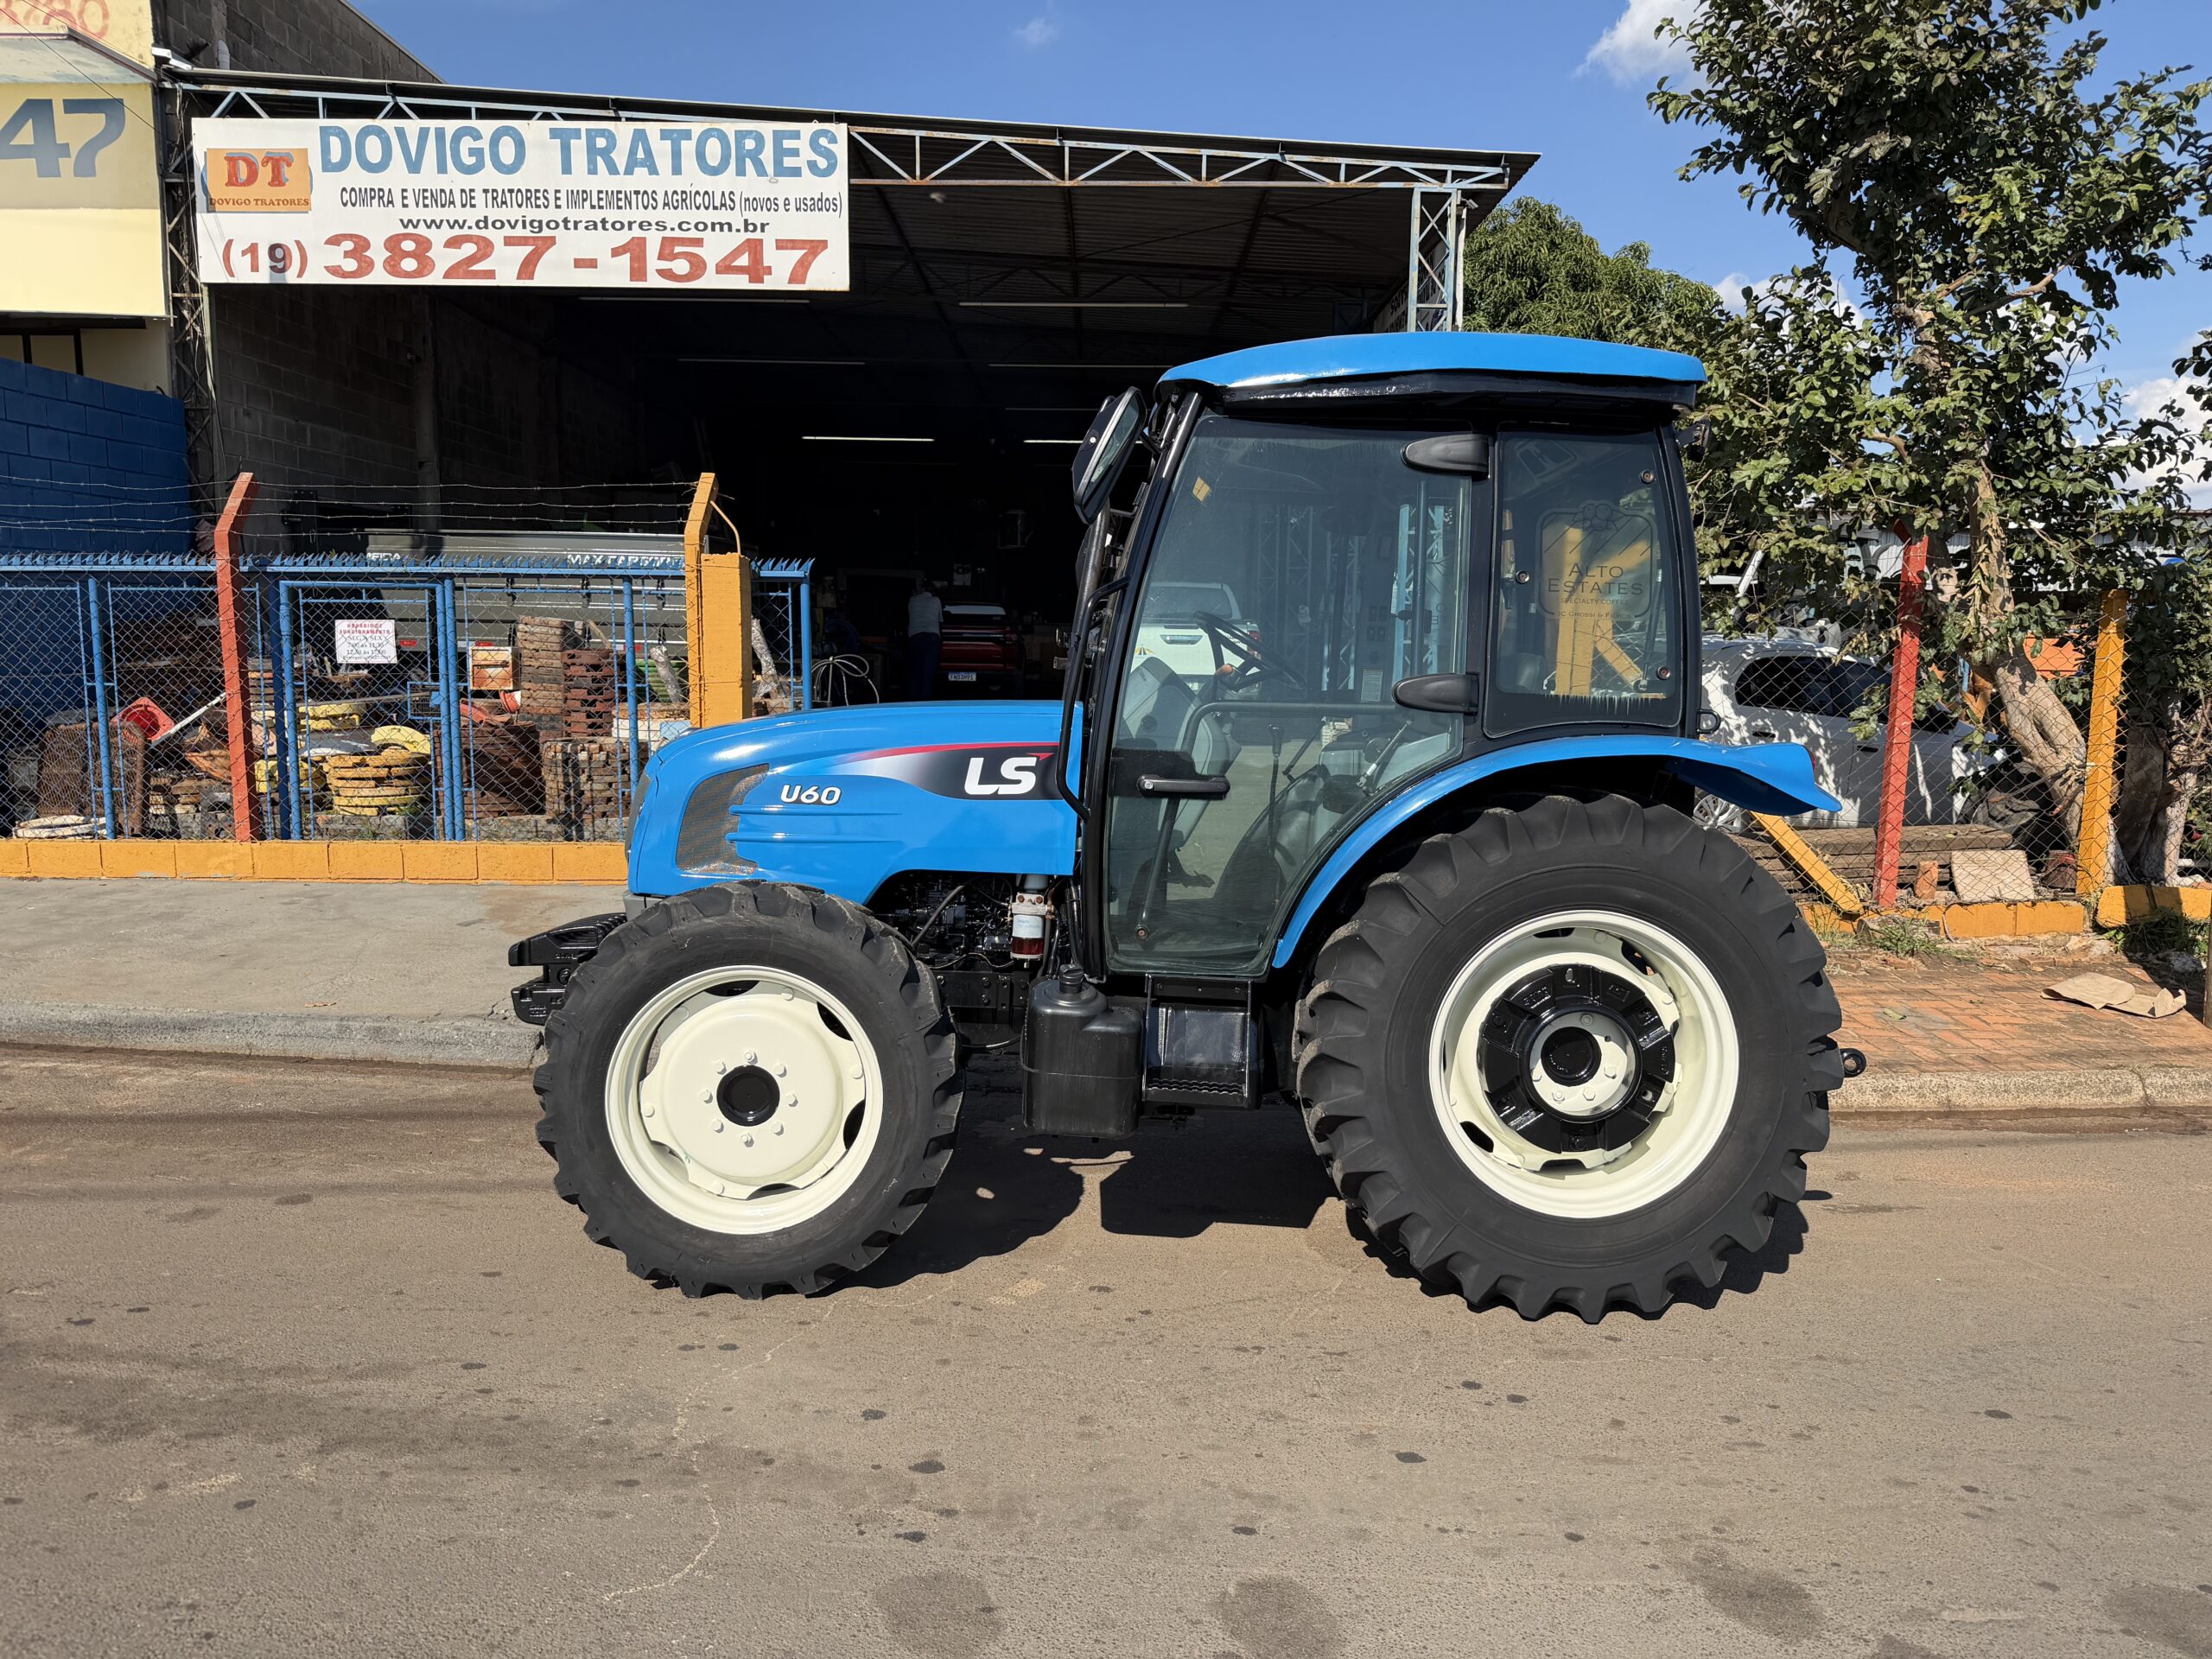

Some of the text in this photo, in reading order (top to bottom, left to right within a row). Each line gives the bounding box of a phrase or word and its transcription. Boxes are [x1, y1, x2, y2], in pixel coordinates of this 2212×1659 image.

[319, 124, 839, 178] DOVIGO TRATORES
[224, 151, 295, 188] DT
[209, 198, 310, 207] DOVIGO TRATORES
[340, 182, 843, 218] COMPRA E VENDA DE TRATORES E IMPLEMENTOS AGRÍCOLAS (novos e usados)
[398, 214, 770, 233] www.dovigotratores.com.br
[223, 232, 829, 285] (19) 3827-1547
[1568, 563, 1624, 578] ALTO
[1548, 578, 1643, 595] ESTATES
[964, 757, 1037, 795] LS
[780, 784, 842, 804] U60
